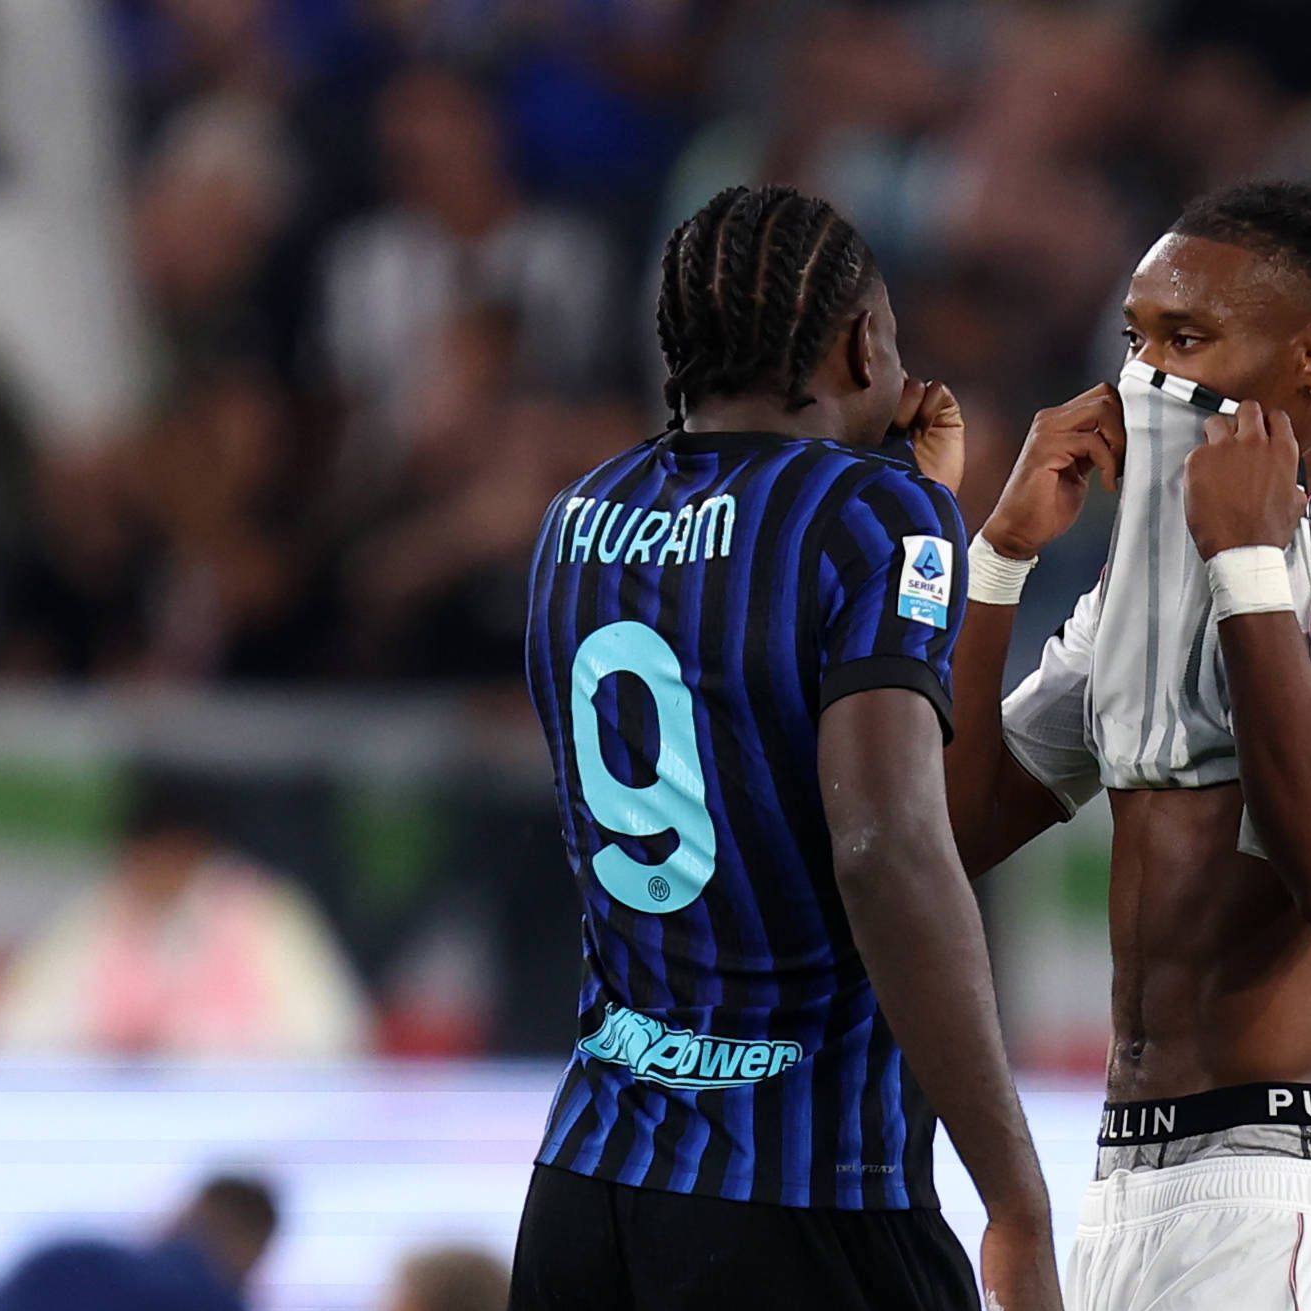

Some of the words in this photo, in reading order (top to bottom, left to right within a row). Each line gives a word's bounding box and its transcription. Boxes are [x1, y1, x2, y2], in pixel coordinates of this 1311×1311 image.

[557, 494, 736, 566] THURAM
[908, 580, 936, 592] SERIE
[937, 586, 944, 596] A
[571, 620, 716, 914] 9
